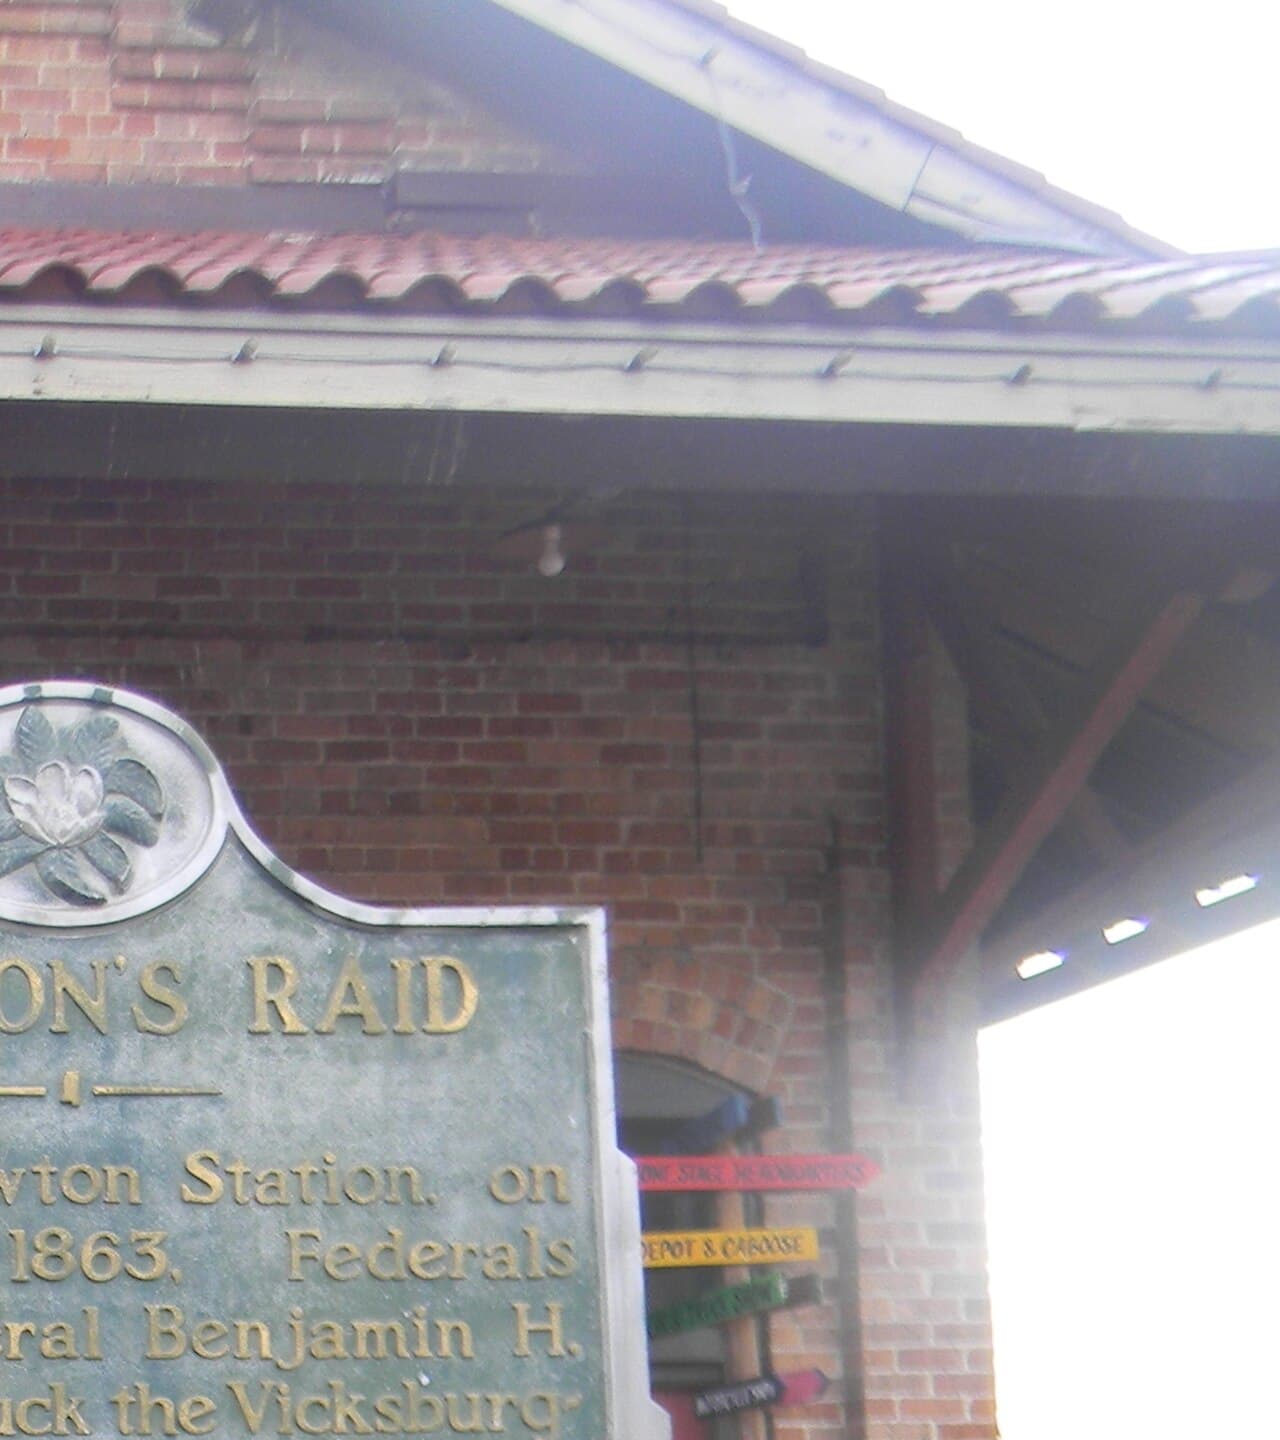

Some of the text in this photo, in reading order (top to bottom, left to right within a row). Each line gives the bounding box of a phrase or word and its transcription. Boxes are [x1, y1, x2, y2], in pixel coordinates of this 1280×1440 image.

[246, 954, 480, 1036] RAID
[488, 1163, 570, 1204] on
[283, 1225, 578, 1283] Federals
[143, 1303, 475, 1372] Benjamin
[511, 1302, 583, 1359] H.
[111, 1381, 218, 1437] the
